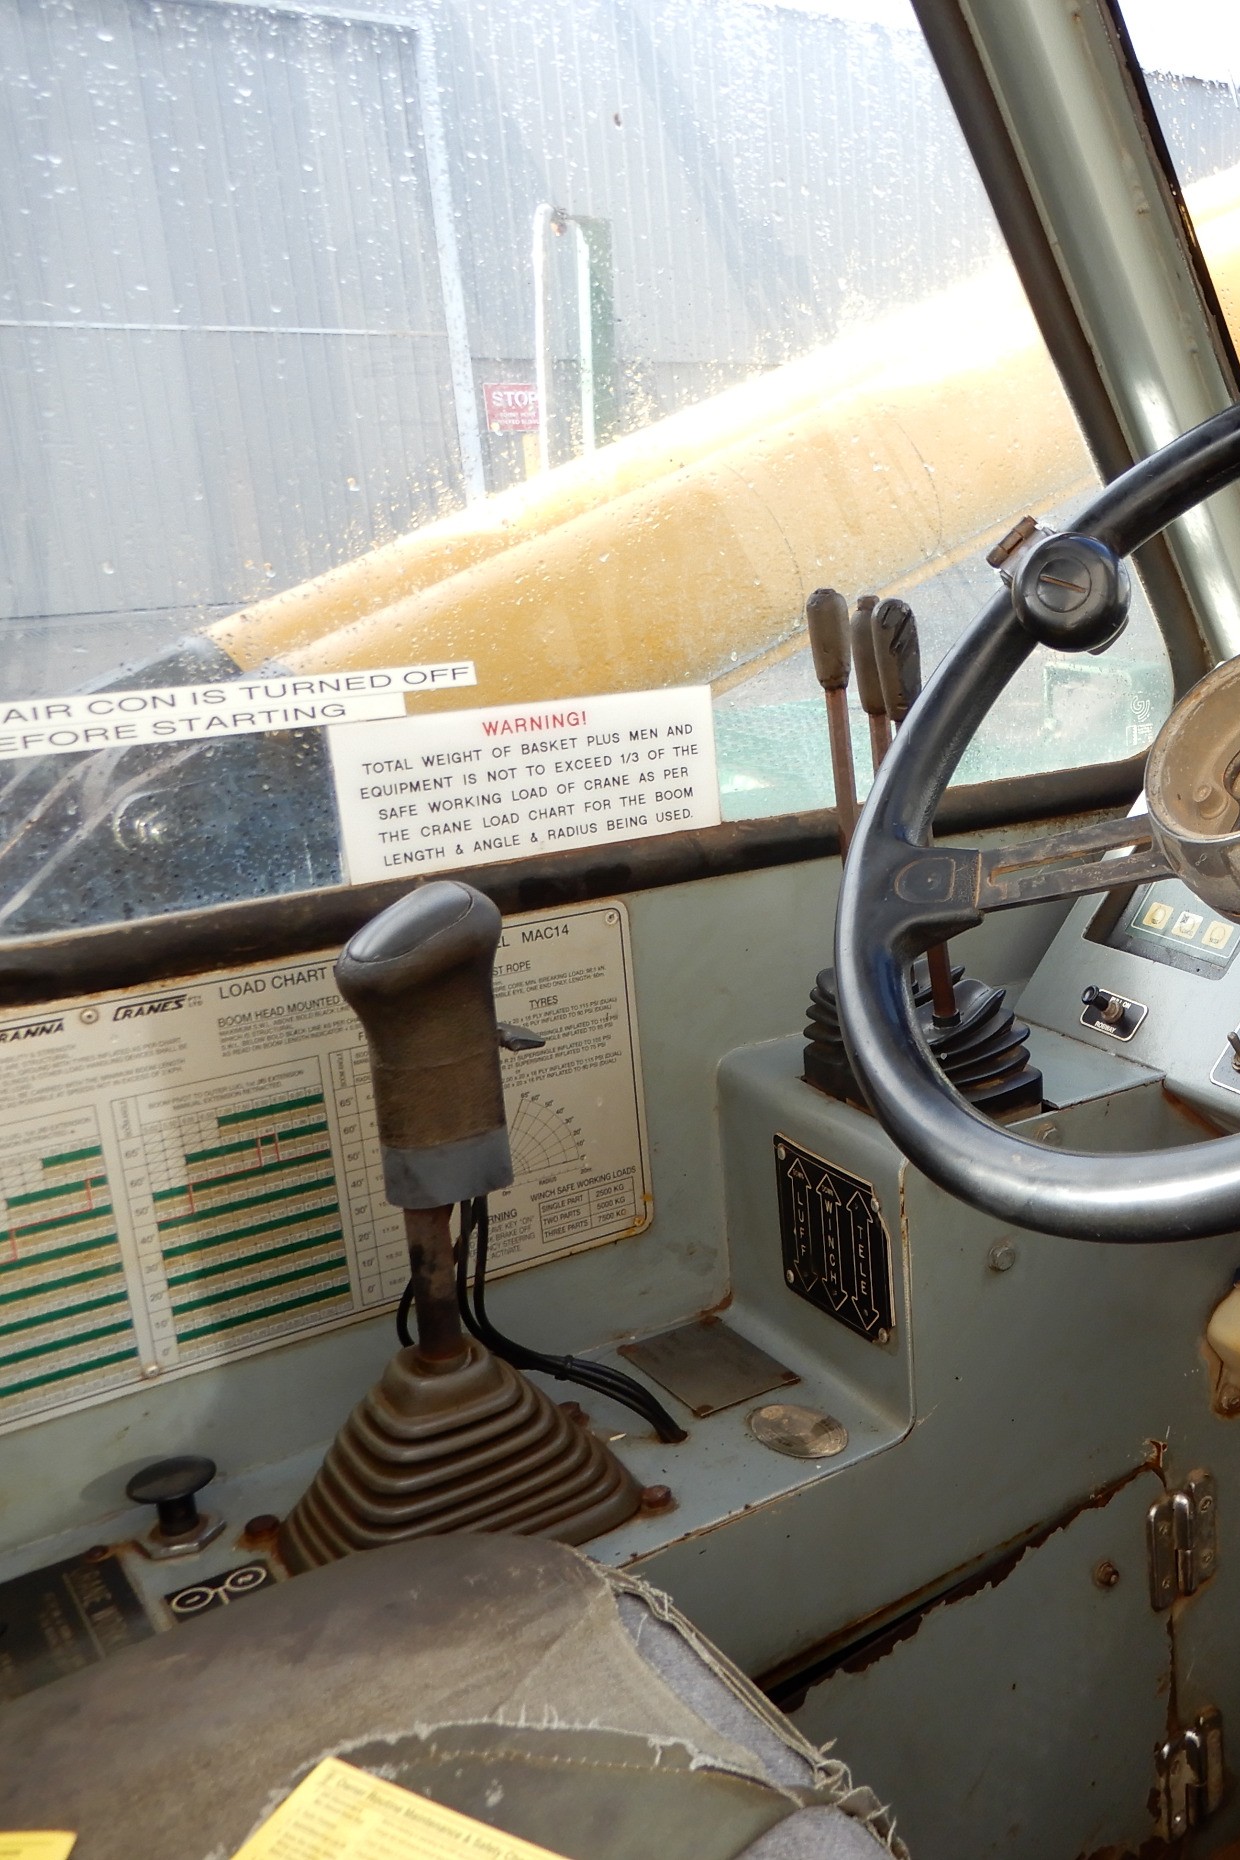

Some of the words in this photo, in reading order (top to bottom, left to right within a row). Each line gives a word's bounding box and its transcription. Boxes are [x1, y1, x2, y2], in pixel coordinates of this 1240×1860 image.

[491, 390, 538, 408] STOP
[3, 704, 73, 725] AIR
[87, 694, 176, 715] CON
[191, 689, 227, 706] IS
[239, 674, 392, 701] TURNED
[403, 666, 470, 686] OFF
[152, 703, 347, 736] STARTING
[481, 710, 588, 737] WARNING!
[361, 758, 414, 776] TOTAL
[421, 749, 483, 767] WEIGHT
[491, 745, 512, 759] OF
[520, 737, 579, 756] BASKET
[587, 732, 621, 747] PLUS
[628, 727, 659, 742] MEN
[666, 723, 694, 737] AND
[359, 775, 453, 800] EQUIPMENT
[462, 773, 478, 787] IS
[487, 767, 518, 783] NOT
[525, 764, 546, 777] TO
[554, 755, 613, 773] EXCEED
[620, 751, 640, 764] 1/3
[647, 748, 666, 761] OF
[672, 743, 699, 757] THE
[378, 804, 418, 821] SAFE
[428, 792, 502, 813] WORKING
[511, 785, 548, 802] LOAD
[556, 782, 576, 795] OF
[584, 774, 631, 791] CRANE
[638, 771, 656, 783] AS
[663, 766, 689, 780] PER
[378, 828, 411, 844] THE
[420, 819, 473, 838] CRANE
[482, 812, 520, 829] LOAD
[528, 804, 576, 821] CHART
[584, 799, 612, 813] FOR
[619, 793, 647, 808] THE
[655, 786, 694, 802] BOOM
[384, 846, 446, 867] LENGTH
[455, 843, 465, 855] &
[473, 834, 521, 852] ANGLE
[530, 832, 539, 843] &
[547, 822, 598, 841] RADIUS
[606, 815, 649, 831] BEING
[655, 808, 694, 823] USED.
[521, 924, 570, 944] MAC14
[218, 979, 267, 1000] LOAD
[271, 966, 328, 990] CHART
[506, 960, 532, 974] ROPE
[112, 993, 188, 1022] CRANES
[217, 1012, 252, 1029] BOOM
[255, 1006, 285, 1020] HEAD
[287, 994, 340, 1013] MOUNTED
[528, 994, 559, 1009] TYRES
[1122, 1001, 1132, 1009] ON
[530, 1189, 556, 1203] WINCH
[556, 1184, 576, 1196] SAFE
[577, 1172, 612, 1189] WORKING
[612, 1165, 638, 1179] LOADS
[541, 1200, 566, 1214] SINGLE
[566, 1195, 584, 1207] PART
[613, 1183, 625, 1192] KG
[543, 1215, 560, 1226] TWO
[560, 1208, 582, 1221] PARTS
[614, 1196, 626, 1205] KG
[796, 1191, 807, 1257] LUFF
[544, 1226, 567, 1239] THREE
[567, 1218, 589, 1232] PARTS
[823, 1198, 838, 1285] WINCH
[856, 1225, 869, 1296] TELE
